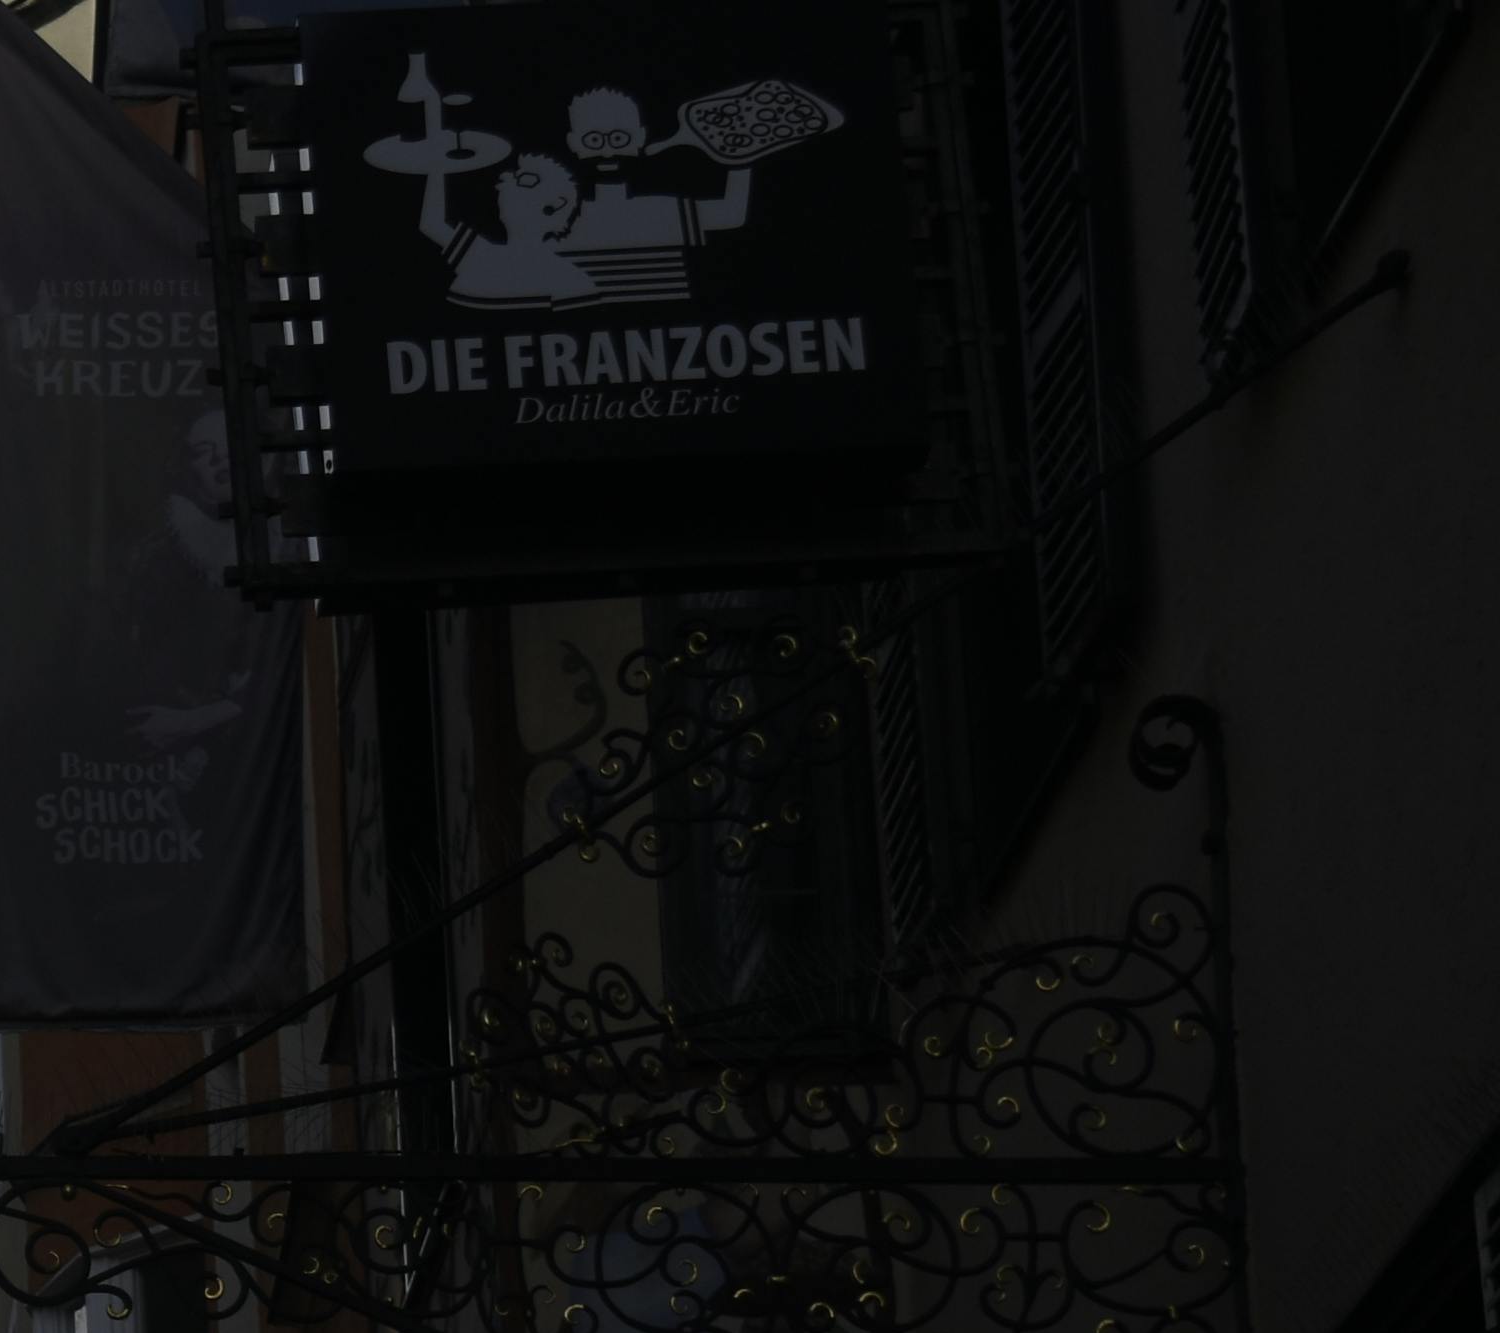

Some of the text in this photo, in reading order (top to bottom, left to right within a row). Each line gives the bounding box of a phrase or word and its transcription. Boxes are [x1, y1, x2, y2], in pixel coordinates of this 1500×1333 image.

[37, 279, 203, 298] ALTSTADTHOTEL
[14, 310, 218, 350] WEISSES
[386, 316, 866, 395] DIE FRANZOSEN
[35, 359, 203, 398] KREUZ
[59, 751, 192, 783] Barock
[53, 826, 204, 864] SCHOCK
